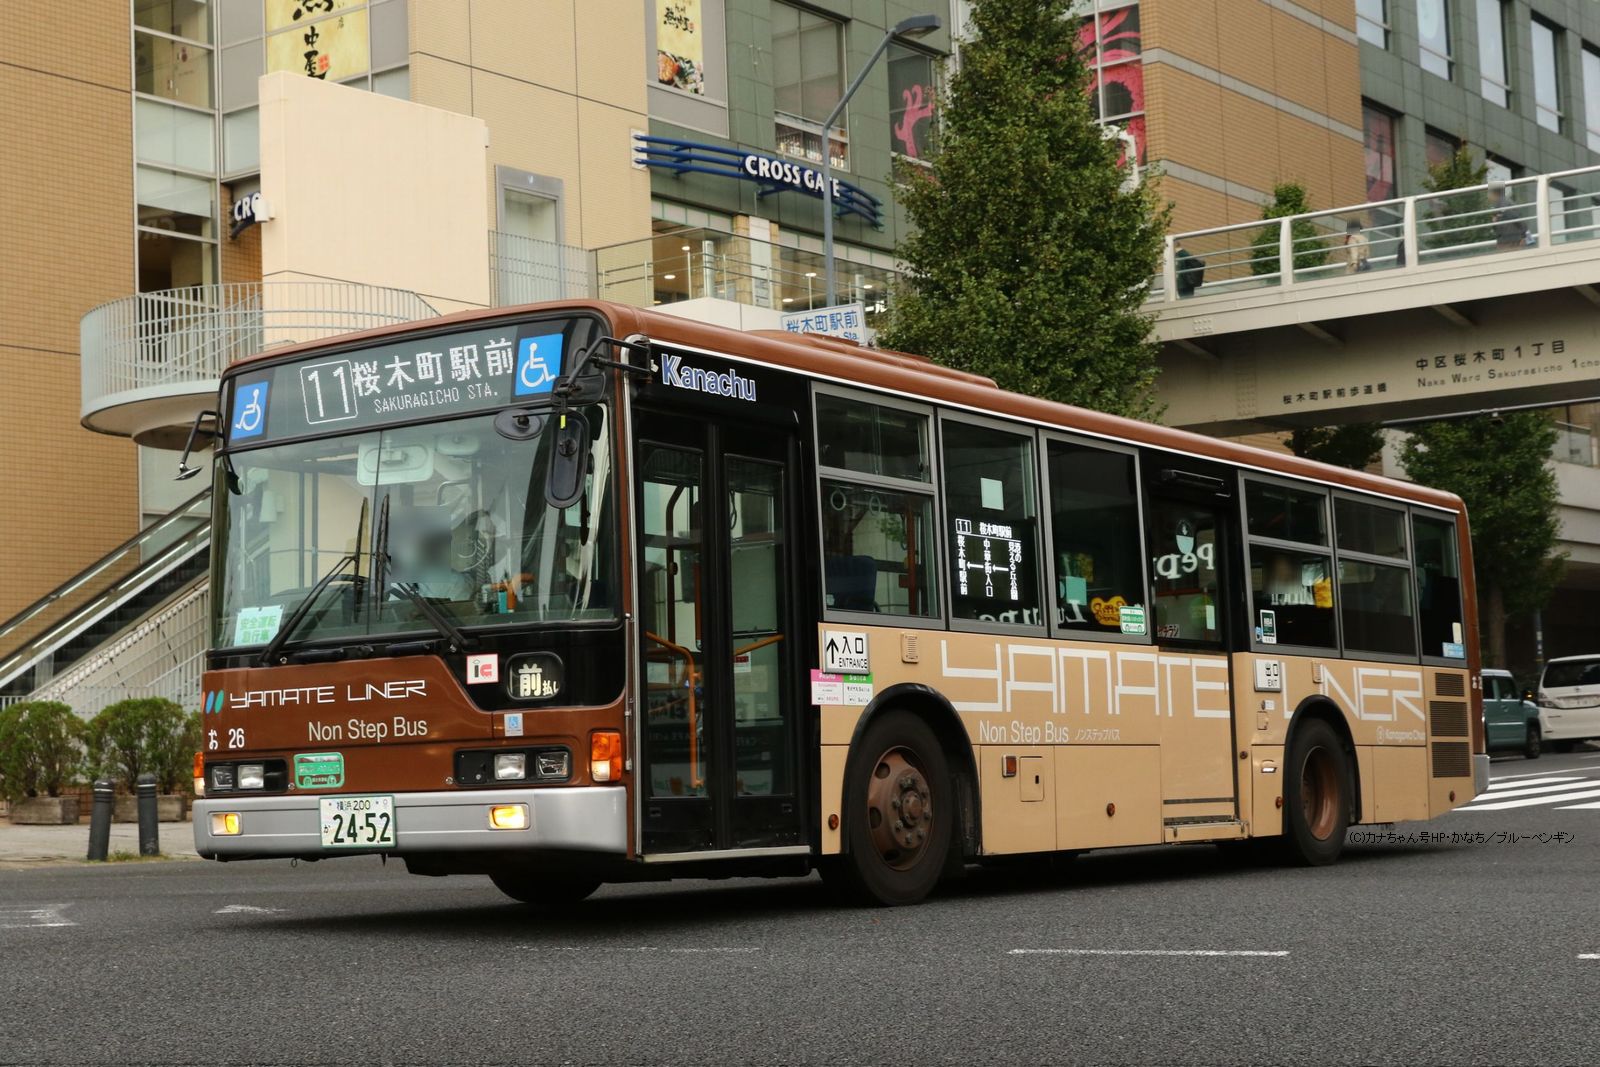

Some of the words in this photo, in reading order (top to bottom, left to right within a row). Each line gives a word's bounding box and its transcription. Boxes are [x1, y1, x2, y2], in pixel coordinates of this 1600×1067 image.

[744, 155, 801, 185] CROSS
[803, 169, 840, 197] GAE
[786, 310, 859, 333] 桜木町駅前
[1416, 340, 1565, 371] 中区桜木町1丁目
[308, 366, 349, 418] 11
[352, 337, 514, 397] 桜木町駅前
[661, 353, 757, 402] Kanachu
[374, 387, 460, 414] SAKURAGICHO
[467, 382, 499, 400] STA.
[842, 636, 864, 654] 入口
[839, 657, 868, 669] ENTRANCE
[229, 686, 335, 708] YAMATE
[347, 680, 427, 702] LINER
[941, 640, 1230, 719] YAMATE
[208, 729, 218, 750] お
[228, 728, 245, 749] 26
[308, 721, 343, 741] Non
[347, 719, 388, 742] Step
[393, 716, 428, 737] Bus
[979, 720, 1007, 743] Non
[1010, 720, 1041, 747] Step
[1045, 721, 1069, 743] Bus
[1075, 728, 1121, 741] ノンステップバス
[333, 812, 391, 843] 24-52
